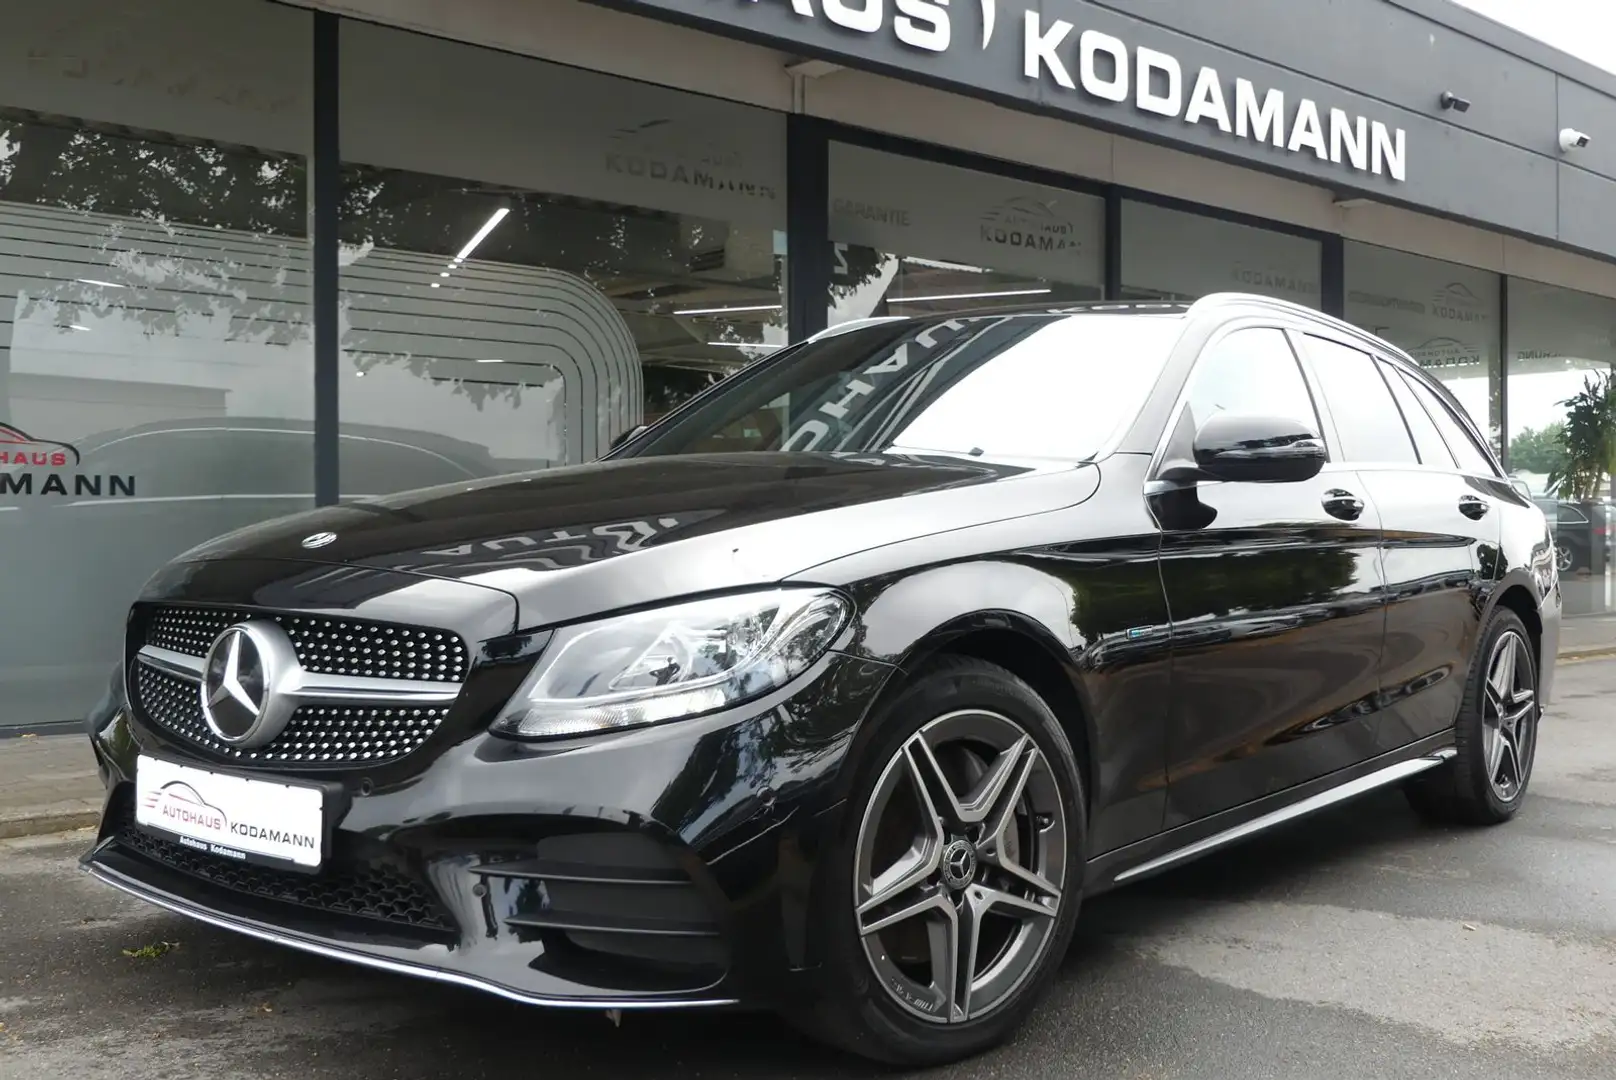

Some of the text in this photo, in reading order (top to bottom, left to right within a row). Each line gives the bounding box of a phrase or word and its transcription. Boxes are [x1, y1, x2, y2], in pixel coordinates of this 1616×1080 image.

[746, 0, 1406, 182] US KODAMANN
[979, 223, 1083, 254] KODAMA
[0, 472, 136, 497] MANN
[162, 804, 315, 850] AUTOHAUS KODAMANN
[179, 835, 247, 860] Autohaus Kodamann
